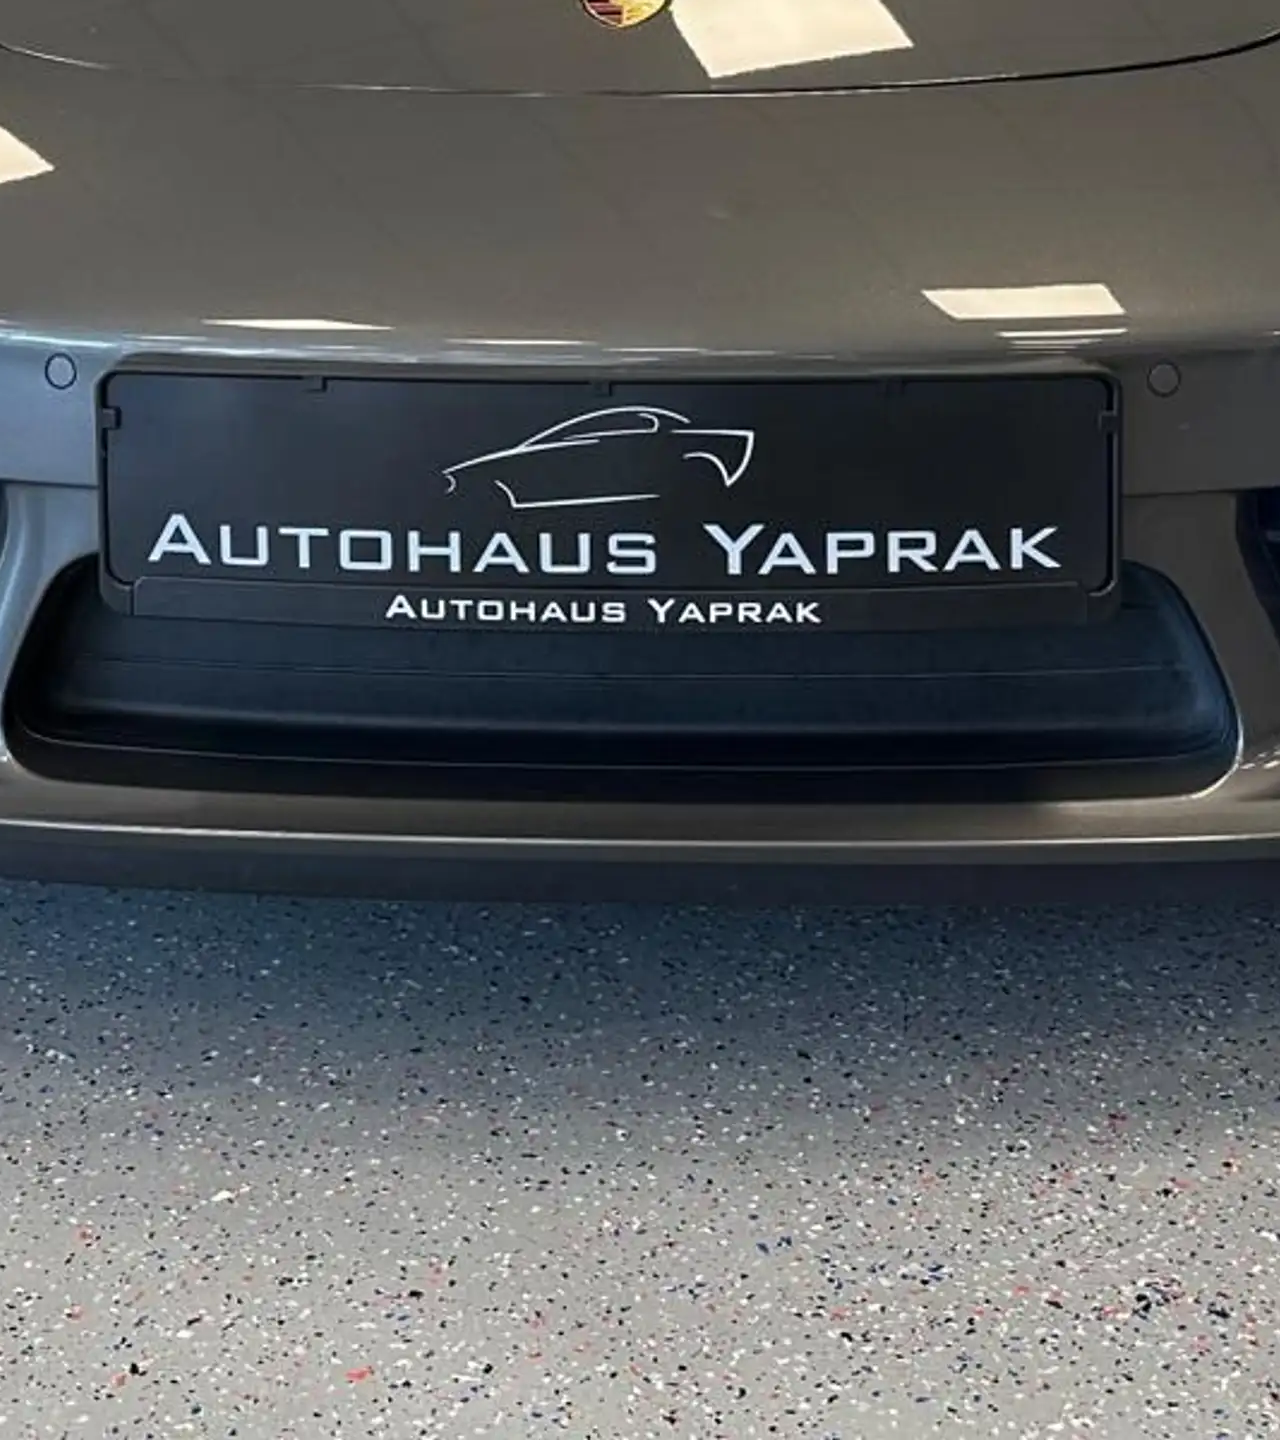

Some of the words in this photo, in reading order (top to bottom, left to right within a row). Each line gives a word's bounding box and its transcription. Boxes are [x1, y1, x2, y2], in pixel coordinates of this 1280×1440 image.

[147, 513, 658, 575] AUTOHAUS
[703, 523, 1062, 576] YAPRAK
[385, 594, 627, 625] AUTOHAUS
[648, 599, 822, 623] YAPRAK
